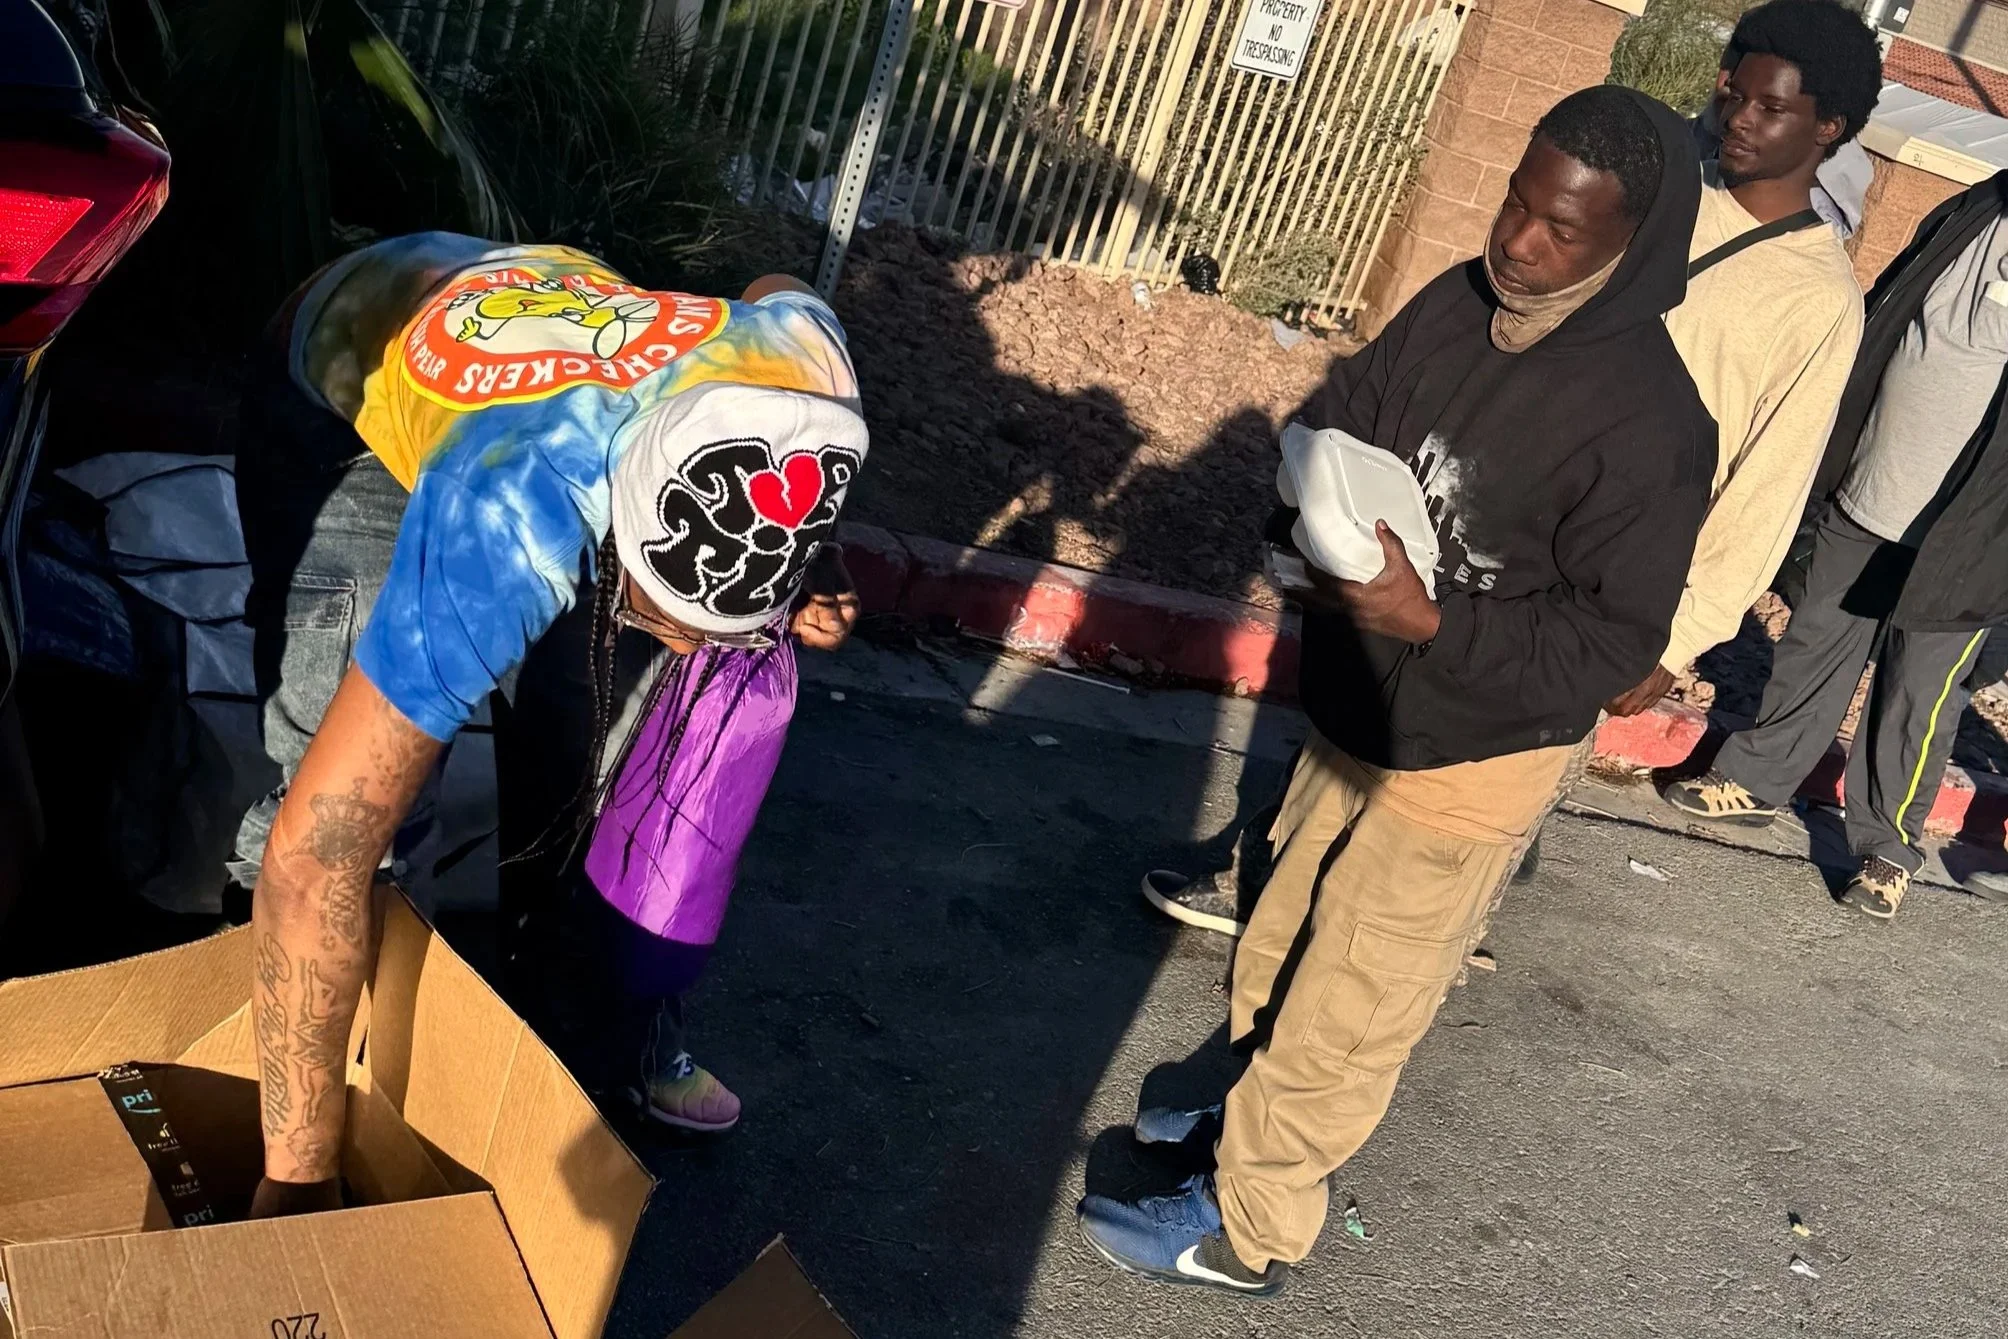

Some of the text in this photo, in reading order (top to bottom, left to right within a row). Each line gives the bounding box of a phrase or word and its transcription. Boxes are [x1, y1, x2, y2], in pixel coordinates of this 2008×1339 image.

[1260, 0, 1307, 22] PROPERTY
[1268, 24, 1283, 41] NO
[1242, 40, 1295, 67] TRESPASSING
[453, 343, 678, 395] CHECKERS
